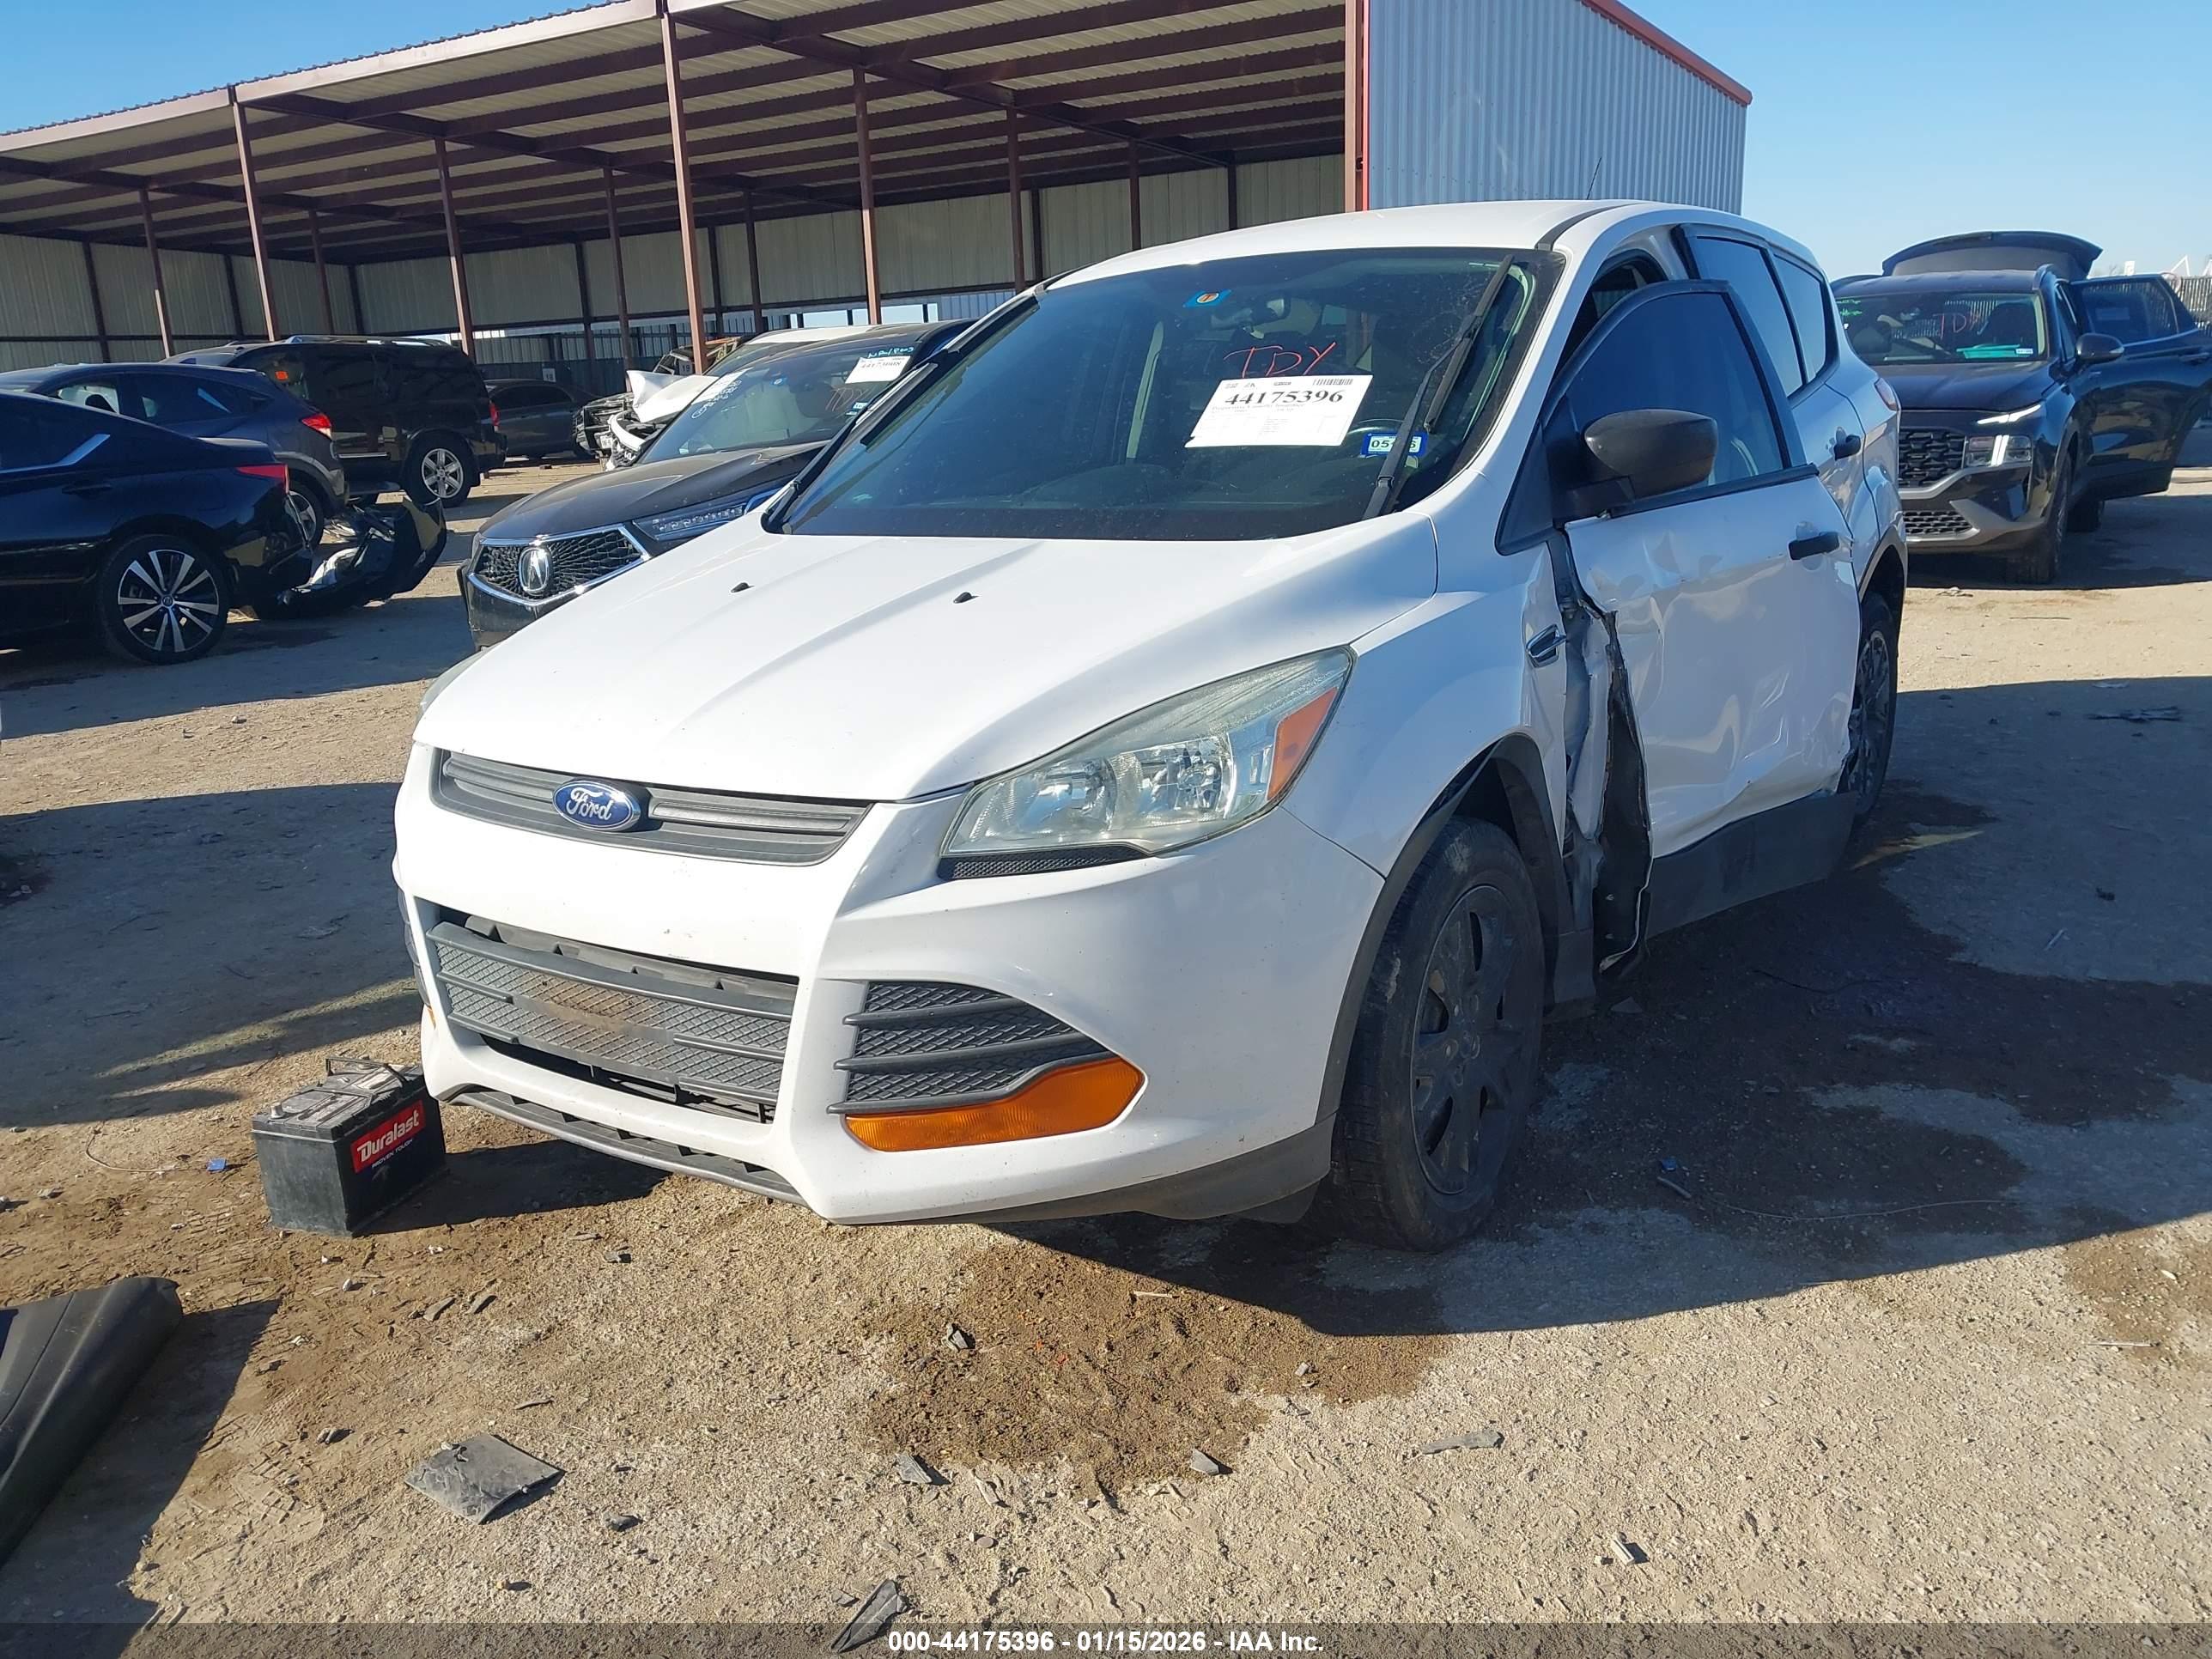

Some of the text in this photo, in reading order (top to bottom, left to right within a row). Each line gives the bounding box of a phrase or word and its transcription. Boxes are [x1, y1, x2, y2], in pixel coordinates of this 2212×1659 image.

[1224, 390, 1346, 404] 44175396
[566, 787, 614, 820] Ford
[356, 1109, 419, 1162] Duralast
